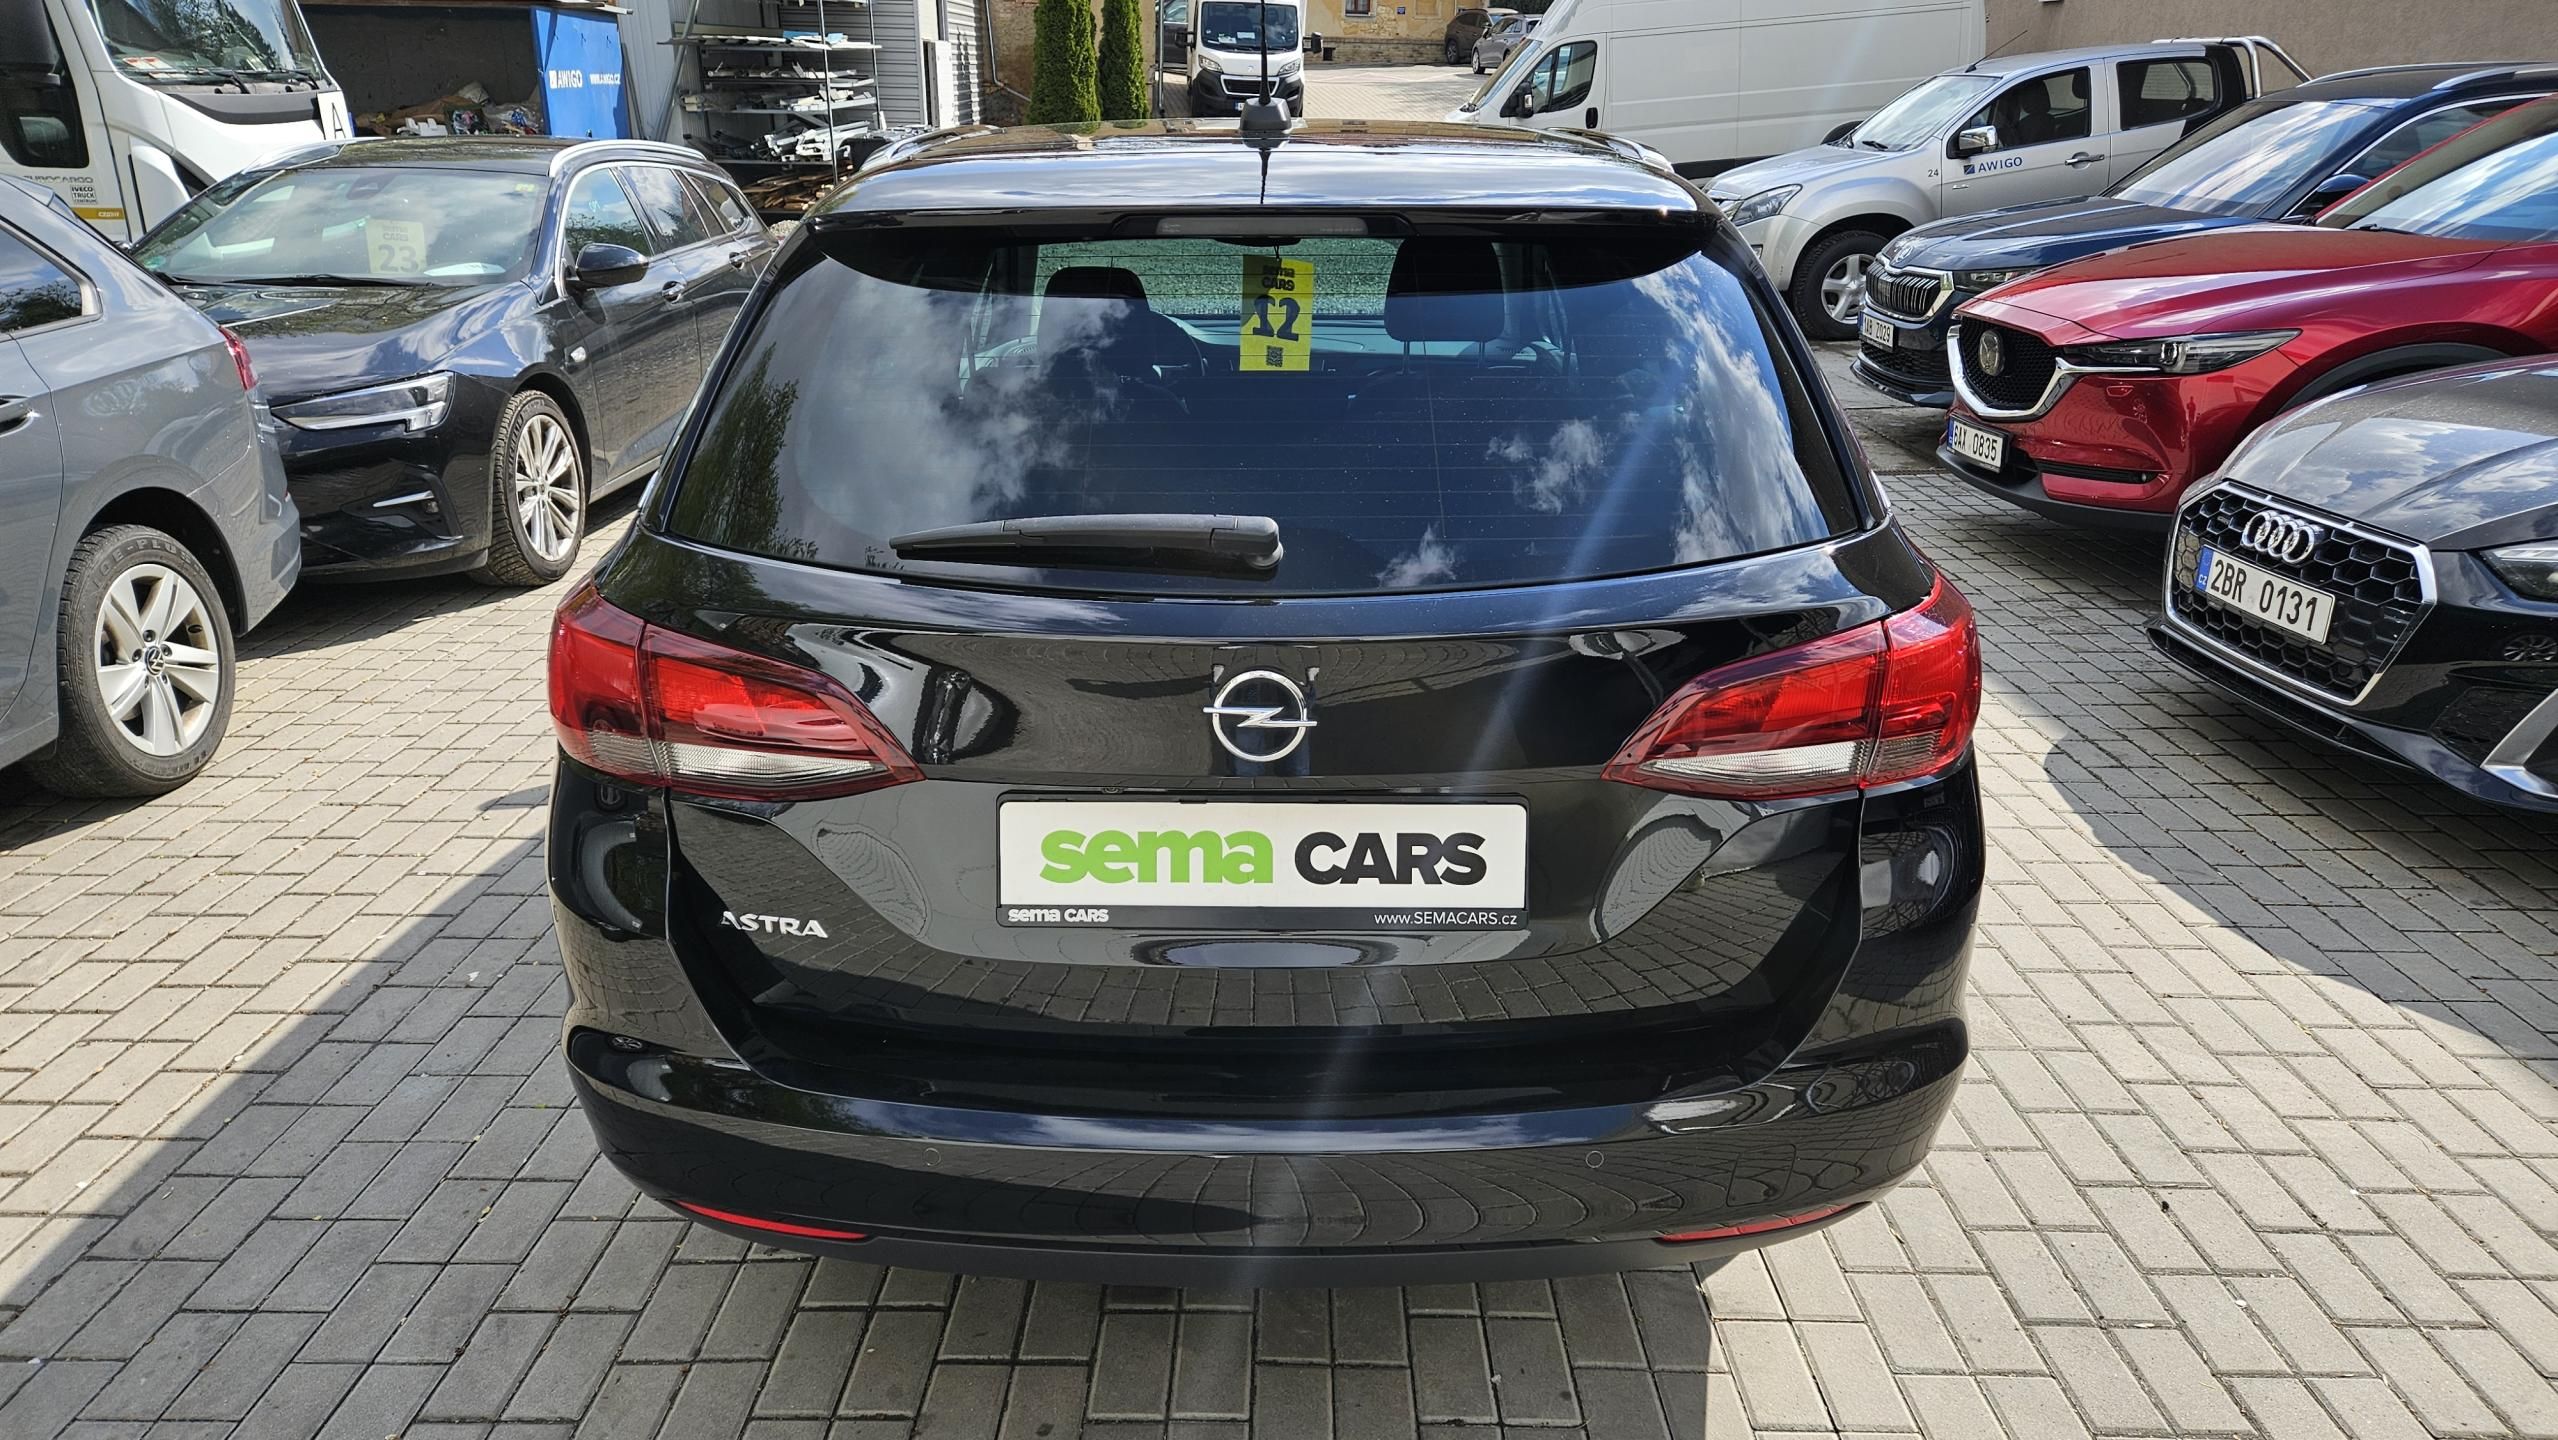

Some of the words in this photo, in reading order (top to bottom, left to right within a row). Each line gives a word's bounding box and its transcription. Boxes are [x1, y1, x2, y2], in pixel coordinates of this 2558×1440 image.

[557, 70, 583, 88] AWIGO
[332, 102, 346, 139] A
[1928, 169, 1939, 177] 24
[1978, 156, 2023, 173] AWIGO
[379, 244, 419, 272] 23
[1262, 277, 1295, 291] CARS
[1253, 295, 1300, 341] 12
[1954, 425, 1968, 450] 6AX
[1973, 433, 1998, 461] 0835
[2198, 573, 2207, 585] CZ
[2210, 559, 2247, 603] 2BR
[2259, 580, 2318, 631] 0131
[1040, 829, 1274, 885] sema
[1294, 831, 1488, 886] CARS
[721, 911, 828, 938] ASTRA
[1008, 908, 1061, 922] sema
[1064, 908, 1109, 922] CARS
[1374, 911, 1518, 925] www.SEMACARS.cz
